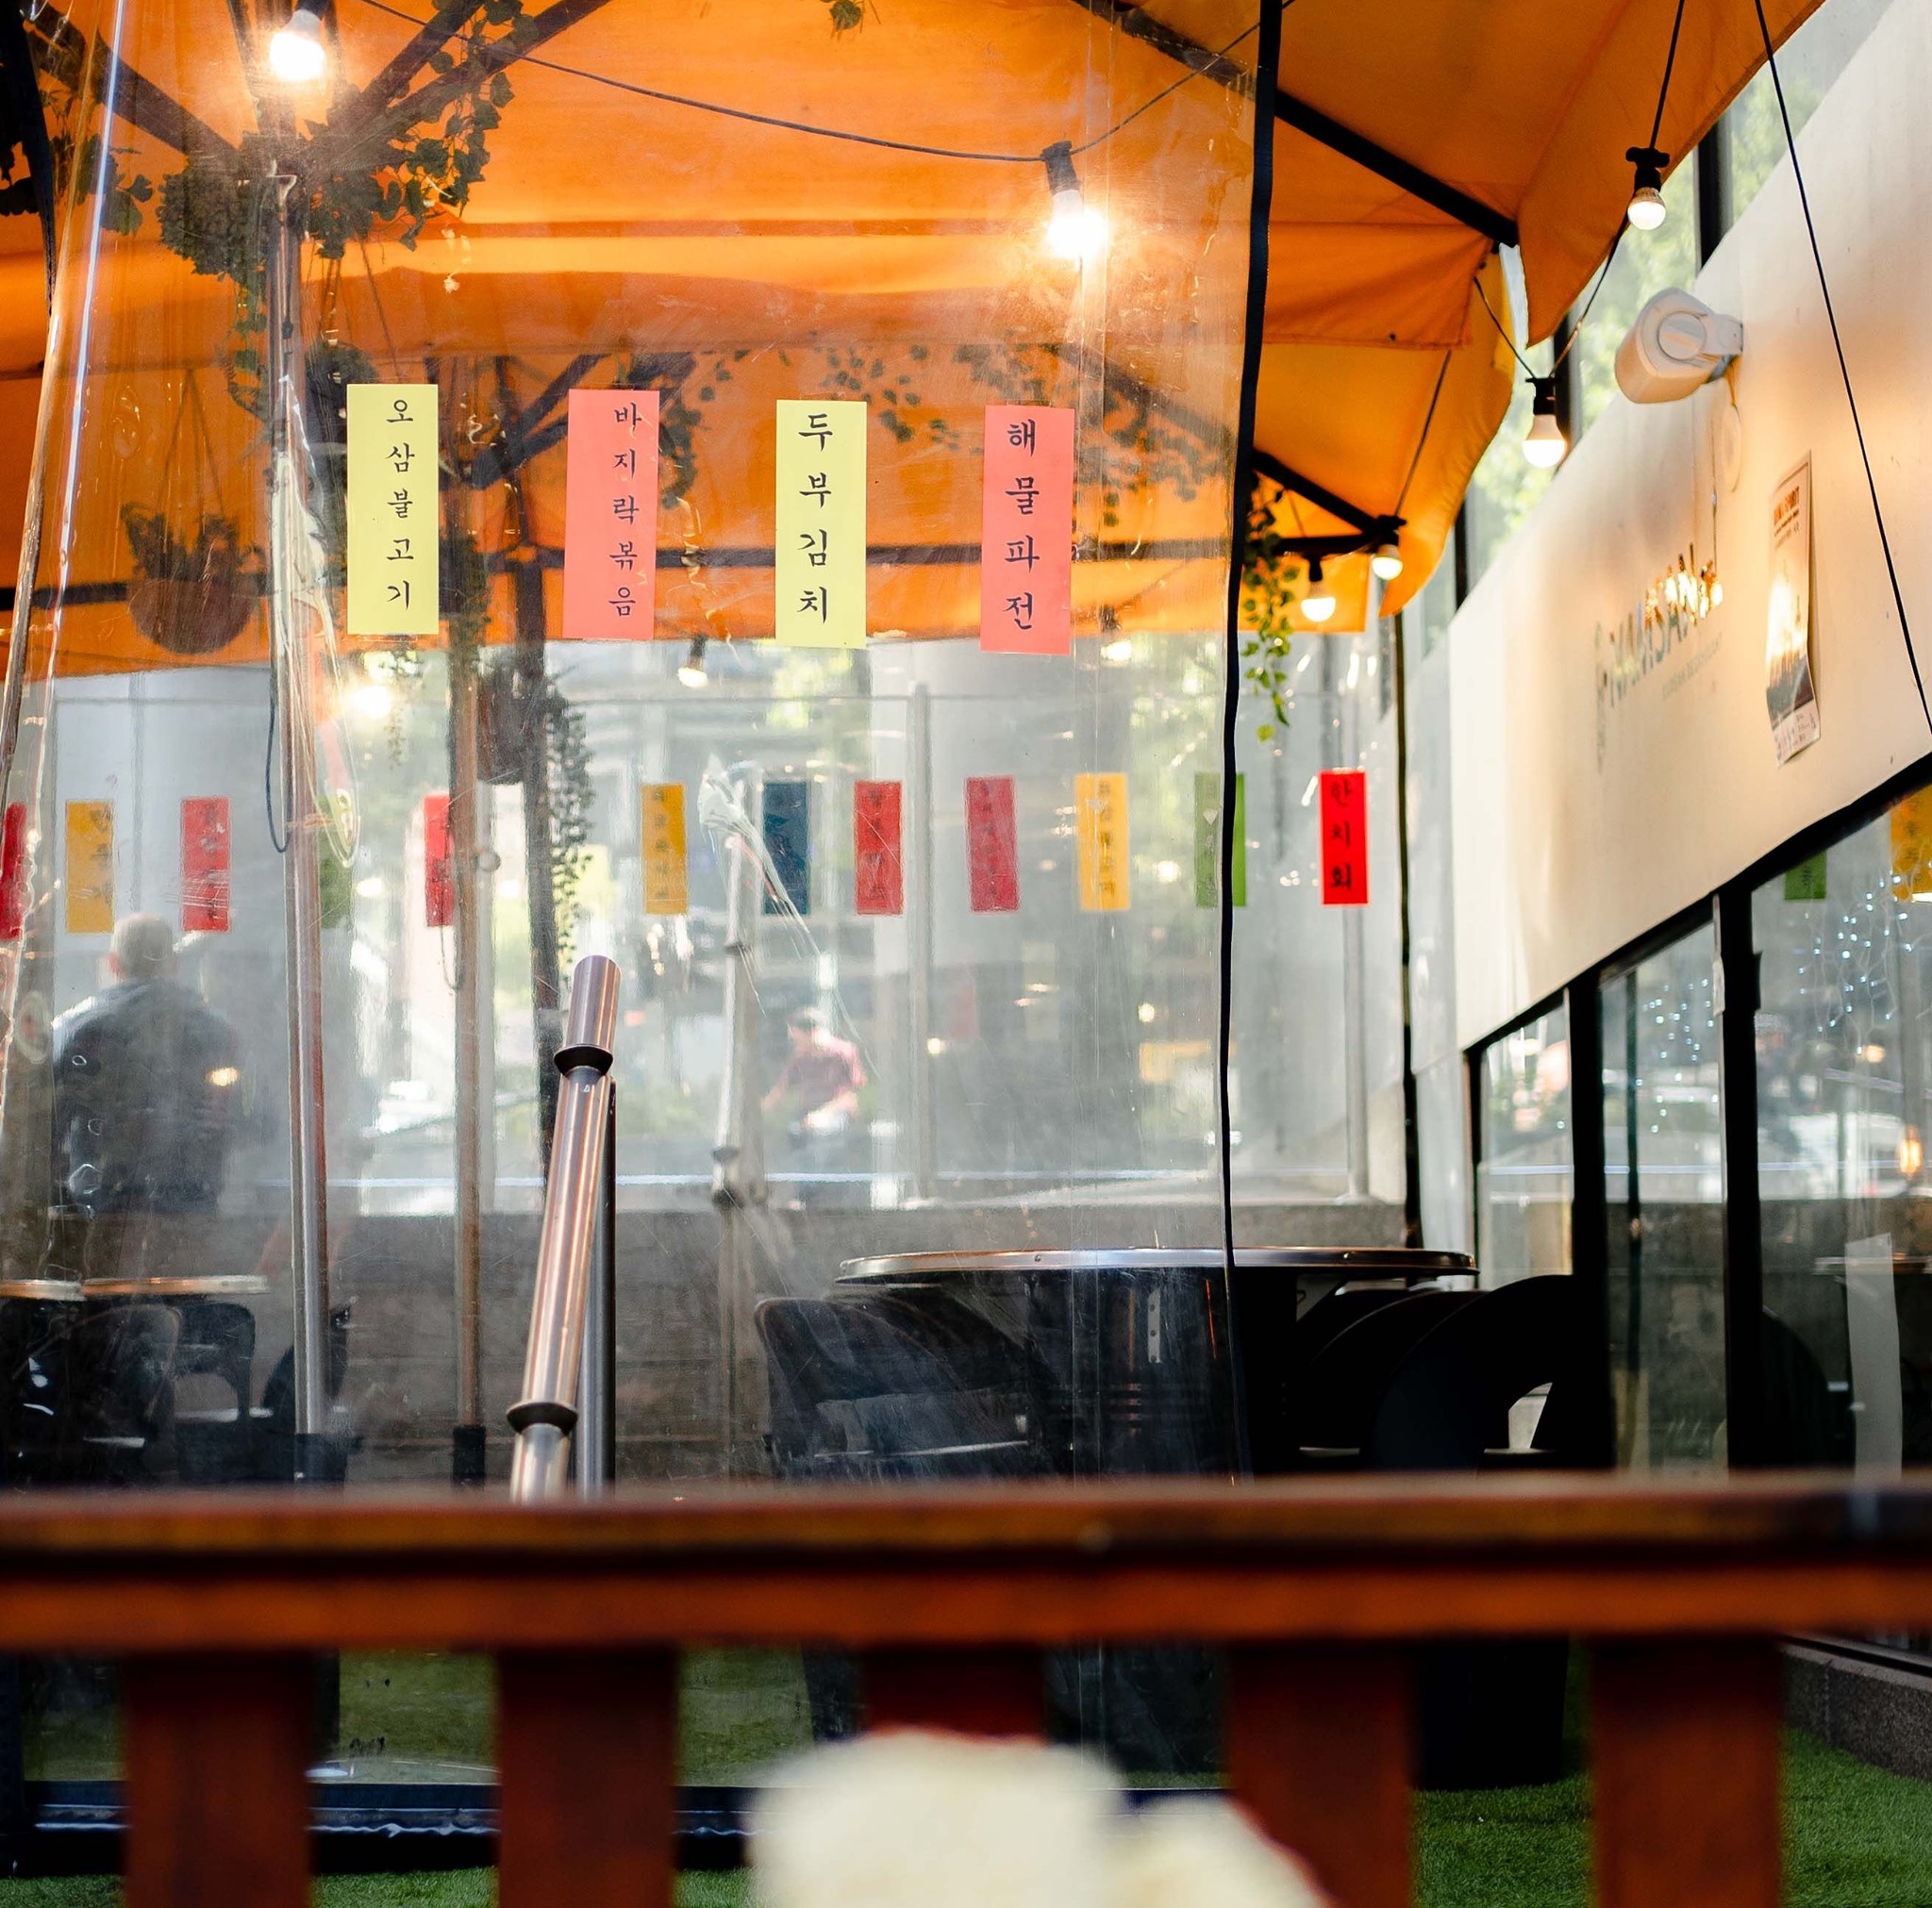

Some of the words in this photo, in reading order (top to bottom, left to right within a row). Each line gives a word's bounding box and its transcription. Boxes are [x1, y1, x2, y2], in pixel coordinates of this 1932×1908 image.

[385, 399, 415, 610] 오삼불고기
[608, 402, 642, 618] 바지락볶음
[796, 412, 833, 624] 두부김치
[1002, 418, 1041, 631] 해물파전
